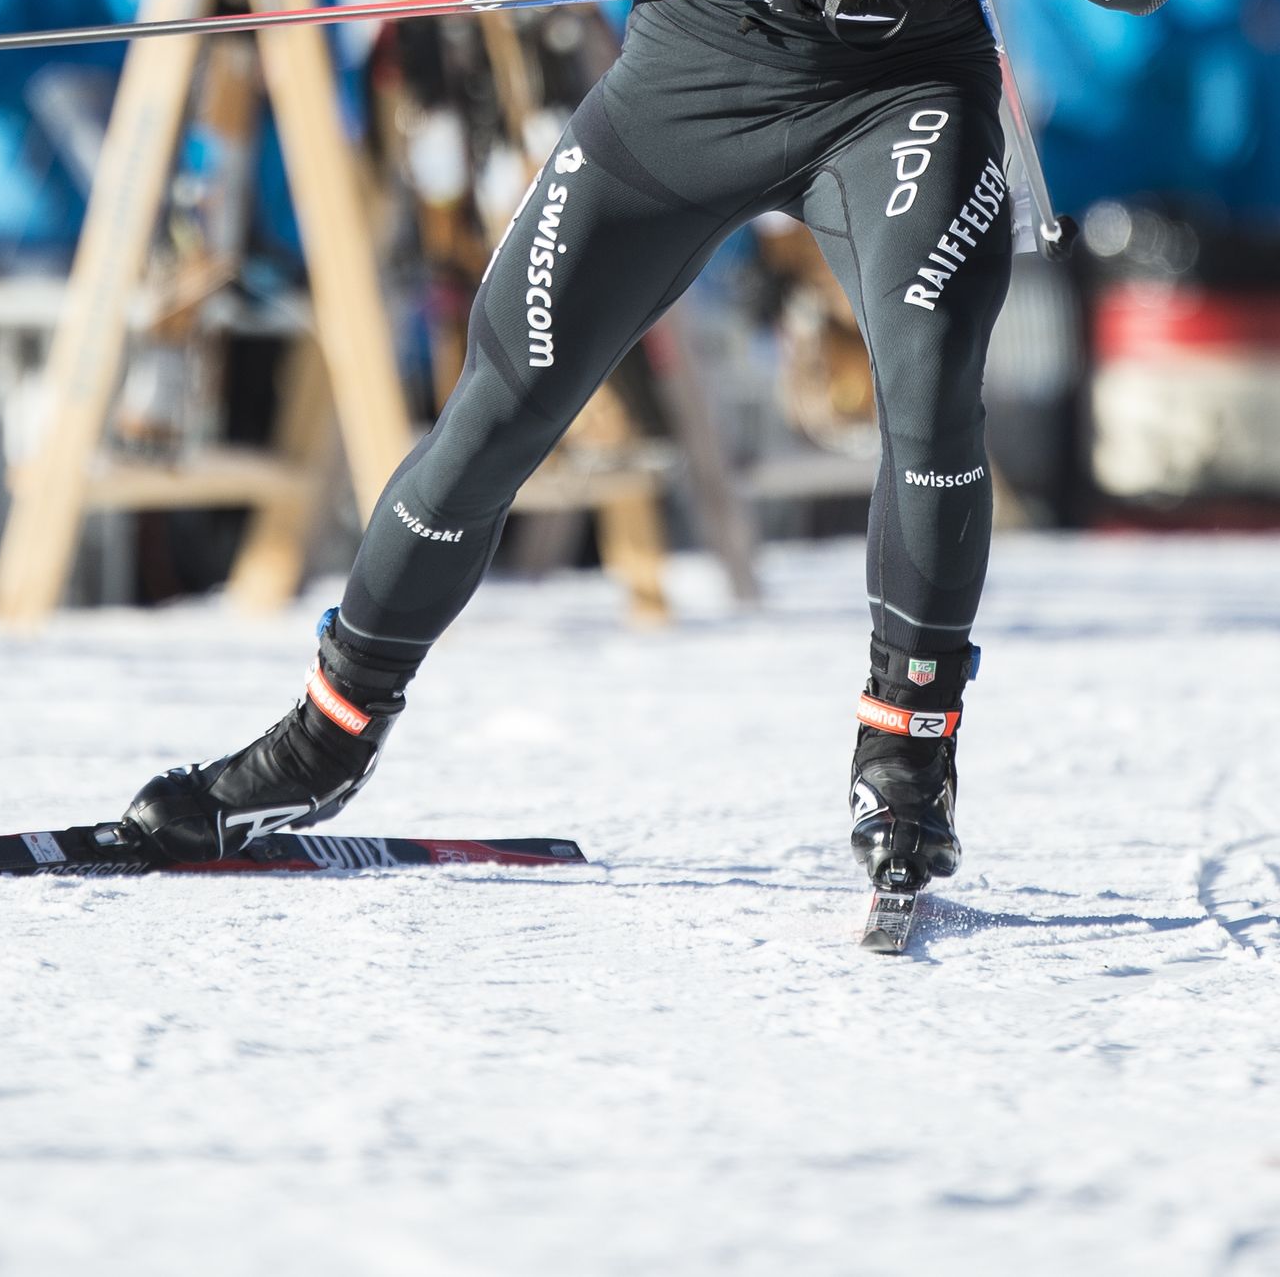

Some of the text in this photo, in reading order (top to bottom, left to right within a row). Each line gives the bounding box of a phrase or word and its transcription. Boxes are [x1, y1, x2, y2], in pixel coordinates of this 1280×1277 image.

[525, 182, 569, 368] swisscom
[903, 157, 1007, 312] RAIFFEISEN
[392, 501, 464, 542] swissski
[904, 465, 985, 488] swisscom
